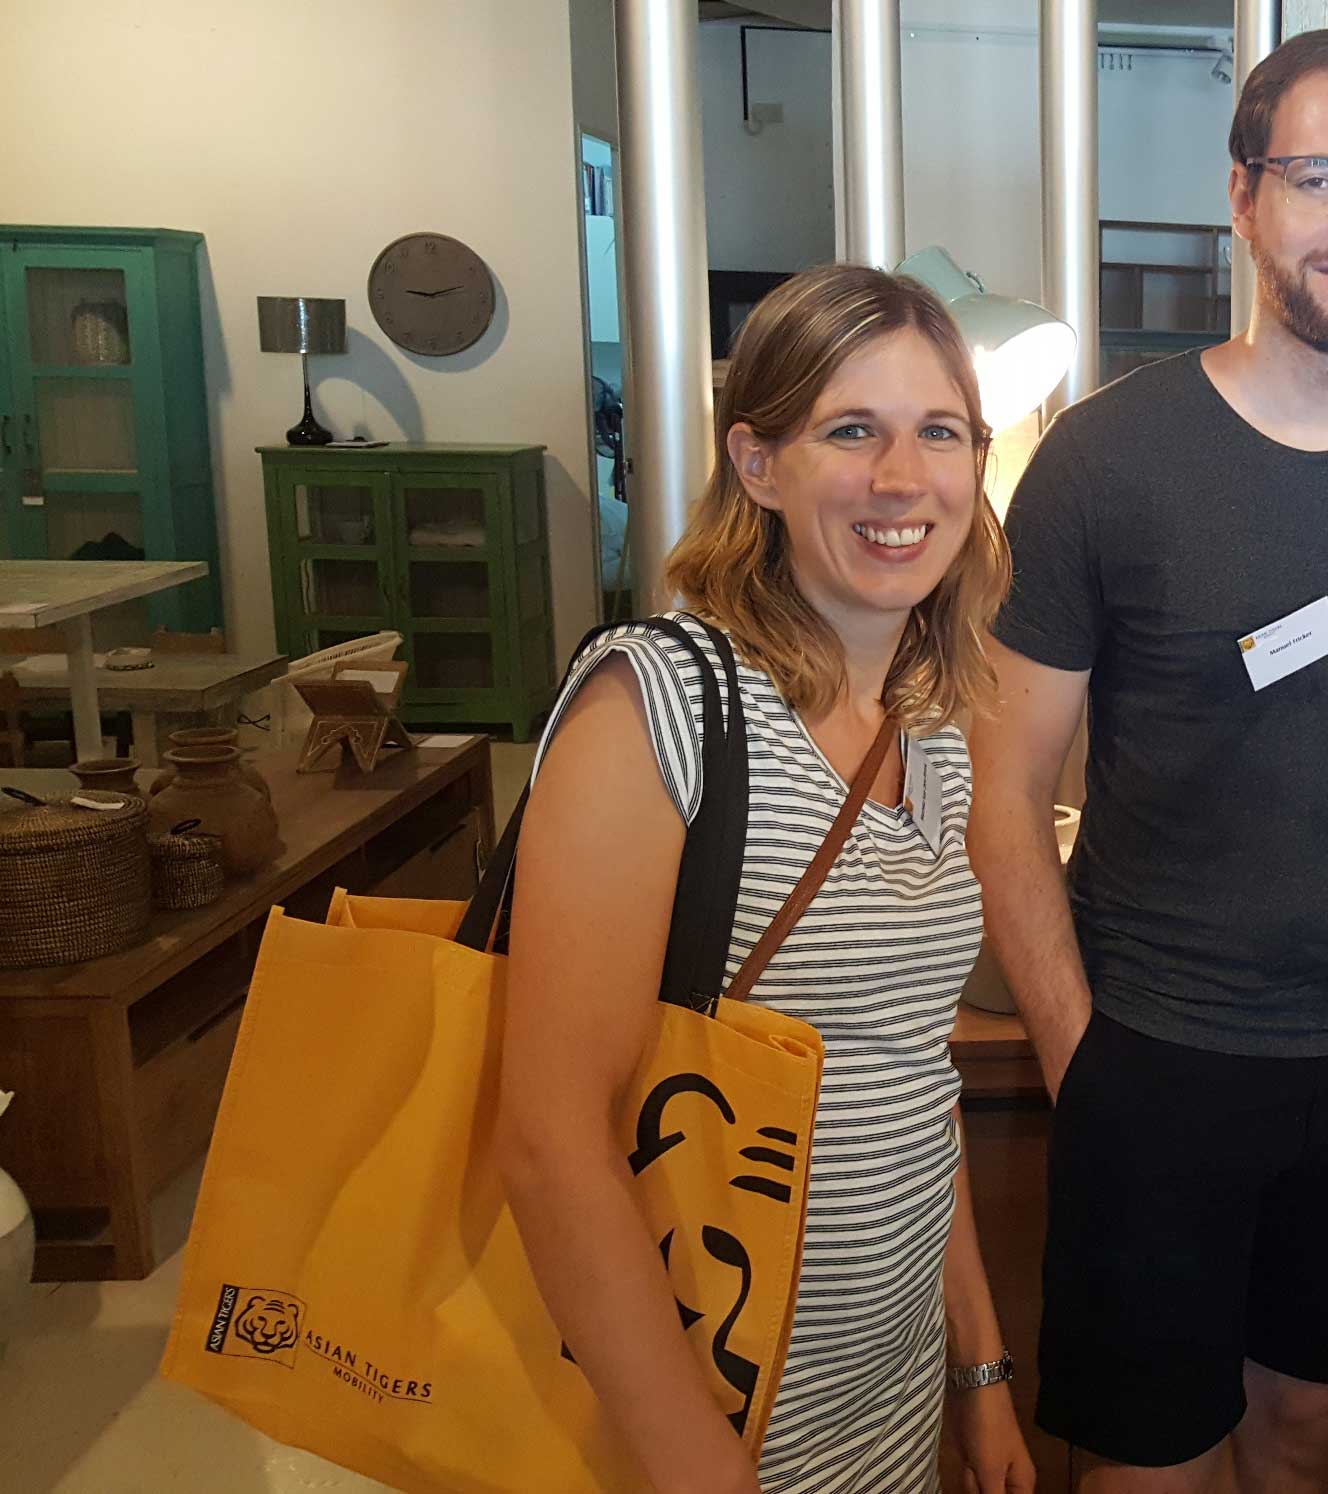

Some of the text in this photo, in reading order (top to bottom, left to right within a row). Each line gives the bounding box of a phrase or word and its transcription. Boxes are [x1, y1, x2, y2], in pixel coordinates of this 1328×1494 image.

[1269, 642, 1292, 655] Manuel
[210, 1287, 236, 1350] ASIAN TIGERS
[305, 1330, 433, 1398] ASIAN TIGERS
[333, 1366, 385, 1404] MOBILITY
